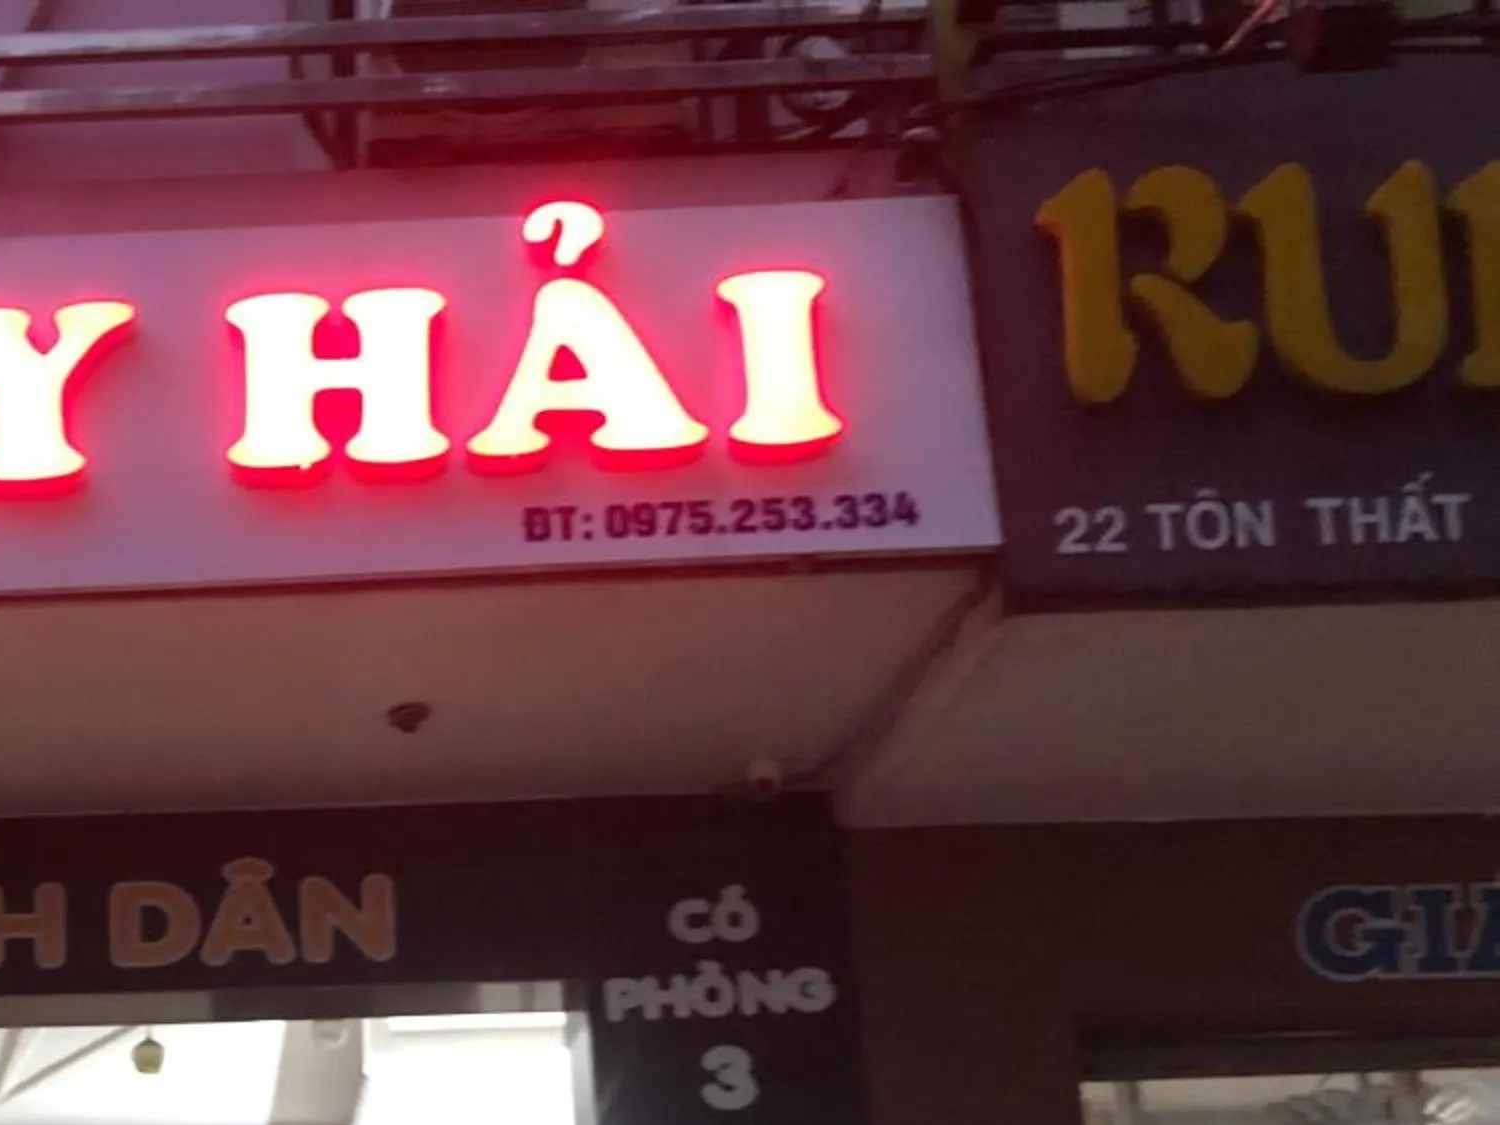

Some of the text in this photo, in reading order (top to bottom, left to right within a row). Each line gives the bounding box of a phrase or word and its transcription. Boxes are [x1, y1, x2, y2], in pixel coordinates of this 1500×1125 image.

[1036, 158, 1500, 402] RU
[225, 200, 843, 469] HẢI
[522, 491, 921, 543] ĐT: 0975.253.334
[1054, 472, 1472, 554] 22 TÔN THẤT
[108, 856, 397, 969] DÂN
[668, 885, 760, 943] CÓ
[603, 960, 836, 1021] PHÒNG
[701, 1045, 760, 1110] 3
